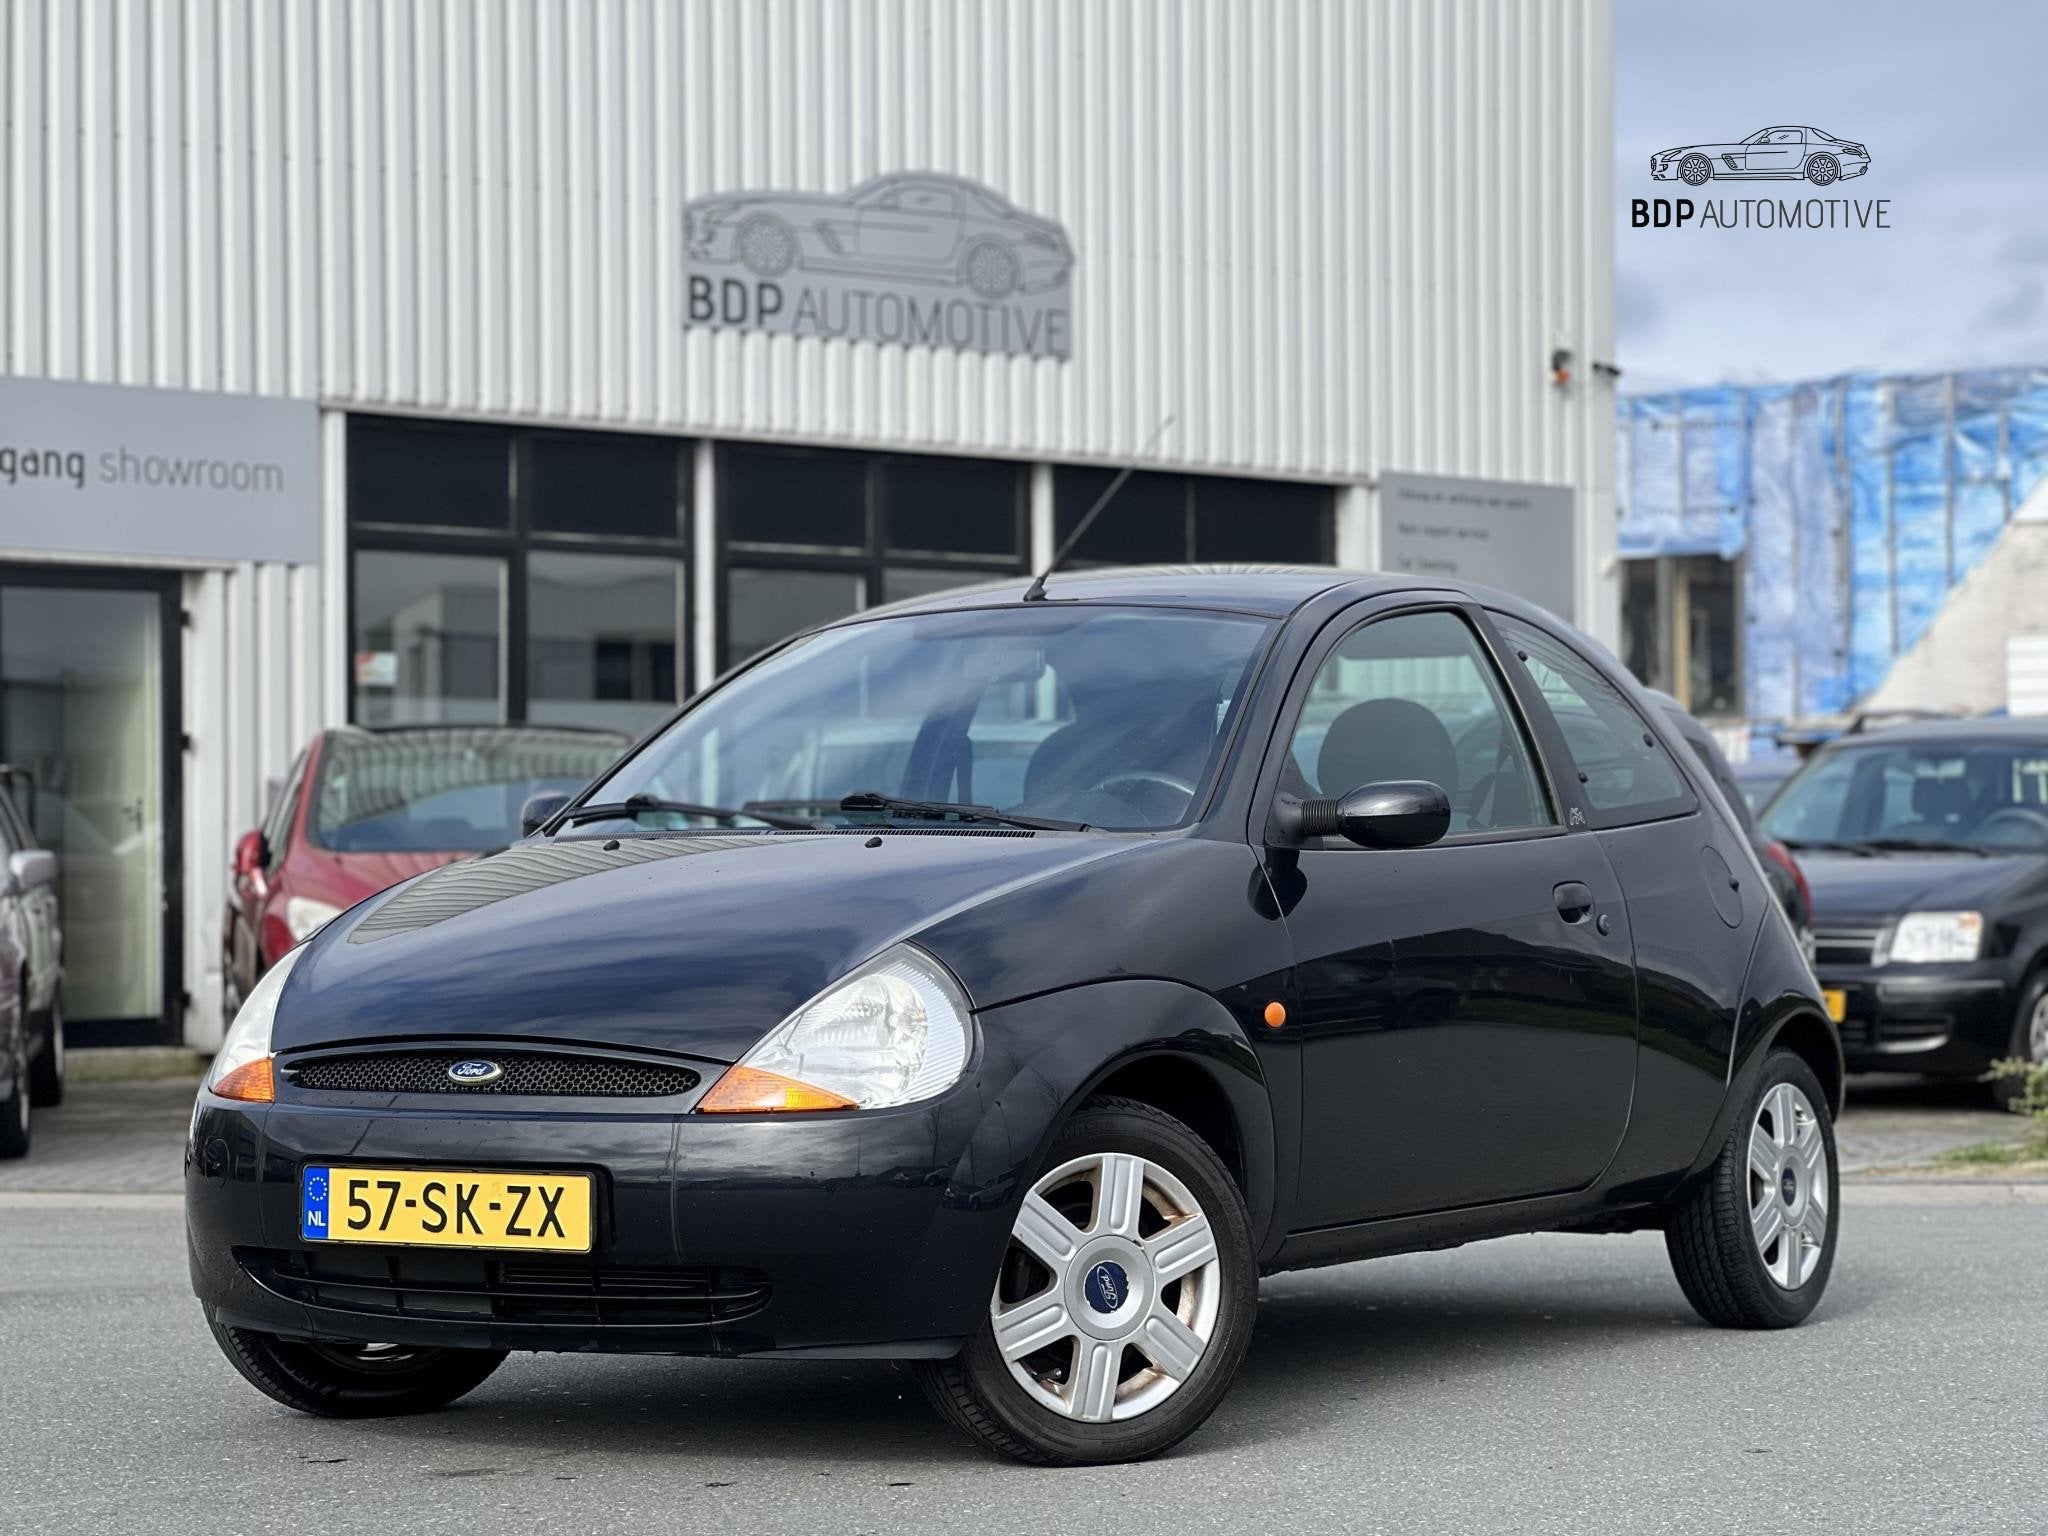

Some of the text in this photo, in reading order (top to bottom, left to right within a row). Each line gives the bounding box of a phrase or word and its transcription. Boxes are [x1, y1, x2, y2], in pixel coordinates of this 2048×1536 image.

[688, 275, 1069, 357] BDP AUTOMOTIVE
[98, 447, 284, 492] showroom
[457, 1062, 487, 1076] Ford
[308, 1211, 326, 1227] NL
[347, 1179, 566, 1238] 57-SK-ZX
[1100, 1273, 1117, 1300] Ford
